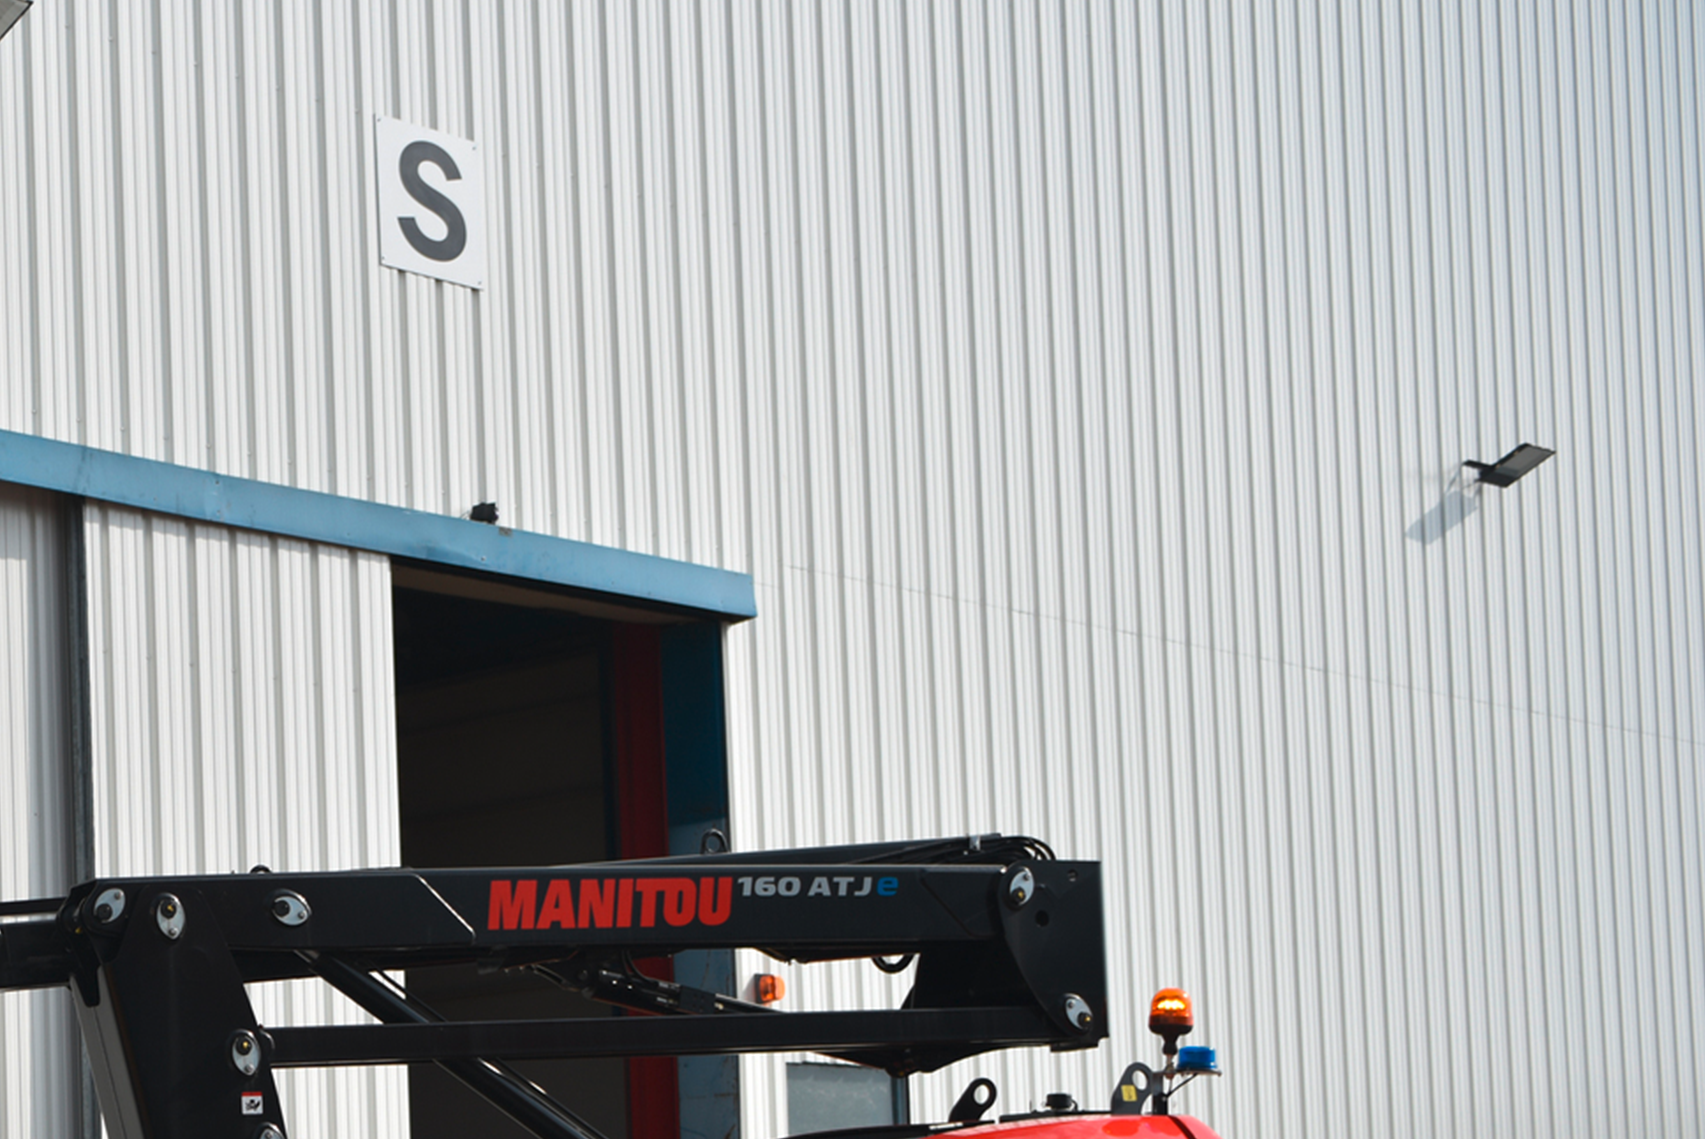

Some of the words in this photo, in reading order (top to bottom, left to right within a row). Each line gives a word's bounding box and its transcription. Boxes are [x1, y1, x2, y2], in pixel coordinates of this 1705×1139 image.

[398, 141, 466, 261] S
[488, 877, 732, 930] MANITOU
[738, 877, 801, 896] 160
